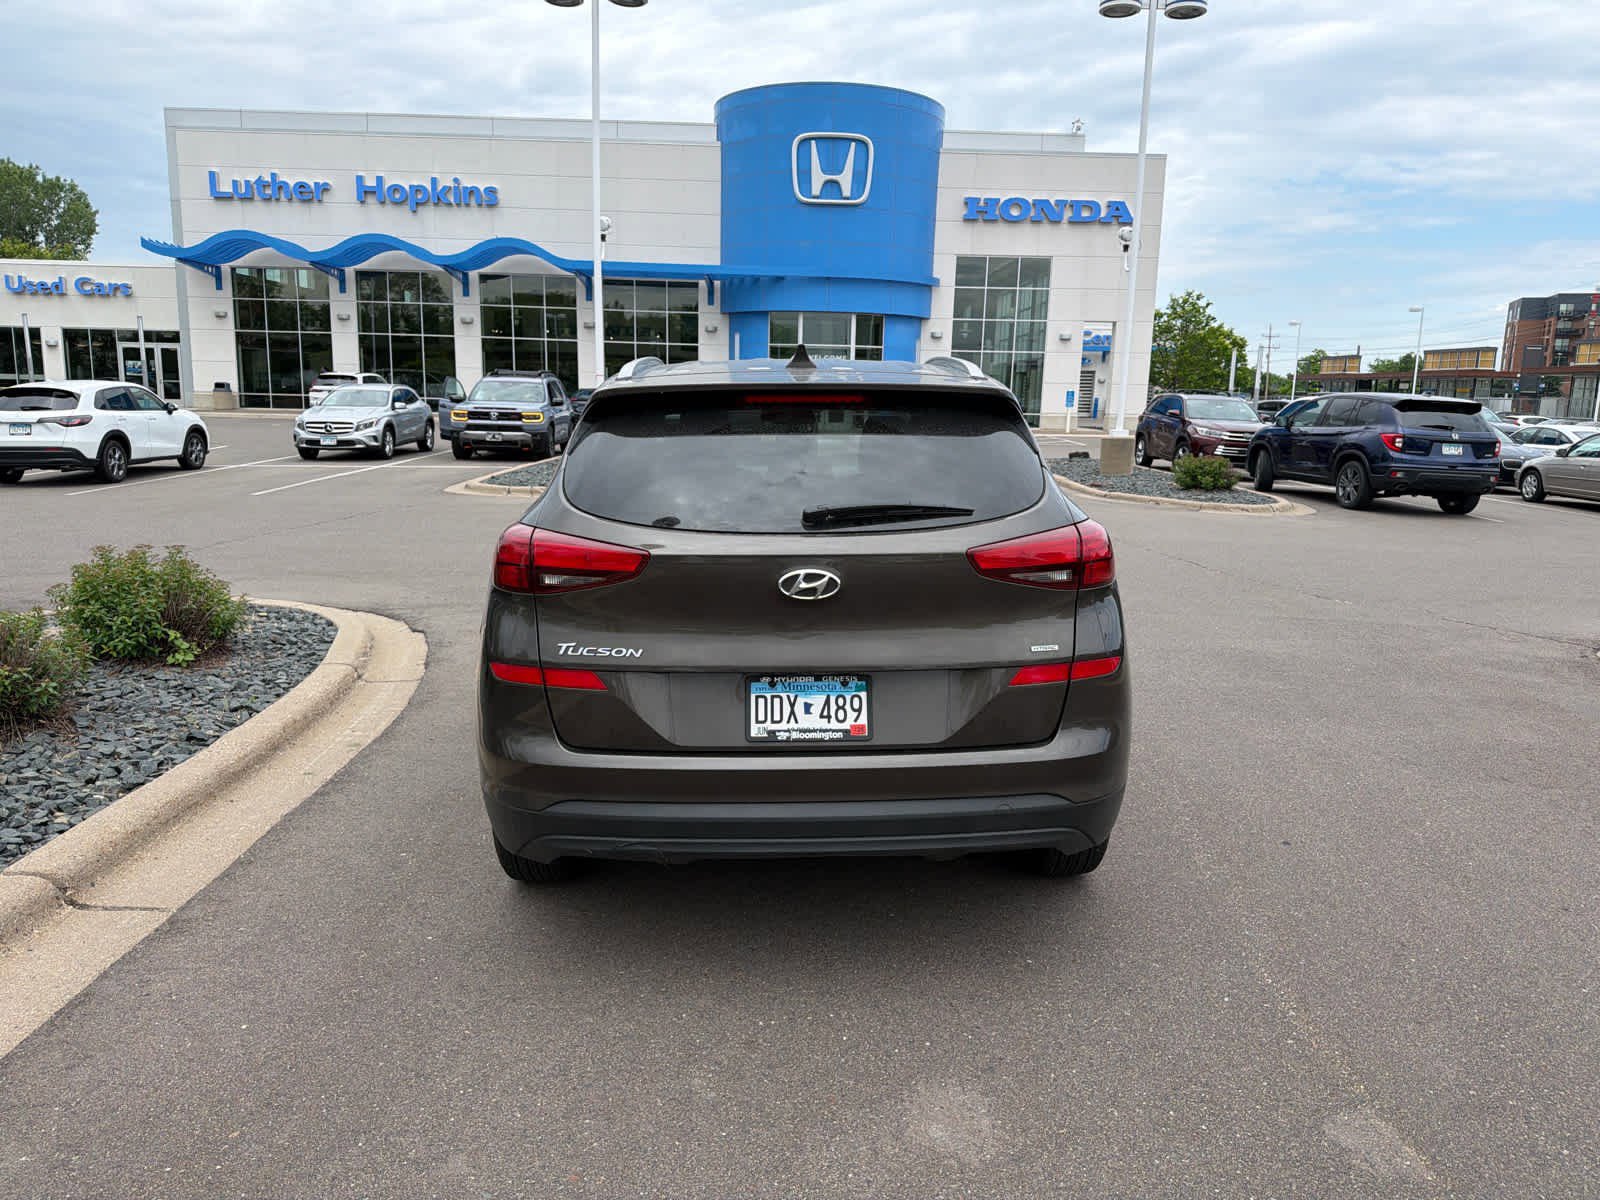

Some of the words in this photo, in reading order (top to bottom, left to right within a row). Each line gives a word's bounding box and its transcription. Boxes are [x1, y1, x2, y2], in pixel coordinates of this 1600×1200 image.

[208, 170, 332, 201] Luther
[355, 174, 499, 212] Hopkins
[963, 197, 1134, 223] HONDA
[4, 274, 66, 295] Used
[74, 276, 133, 297] Cars
[774, 675, 815, 683] HYUNDAI
[782, 681, 837, 692] Minnesota
[754, 694, 799, 724] DDX
[819, 694, 863, 724] 489
[793, 729, 843, 740] Bloomington
